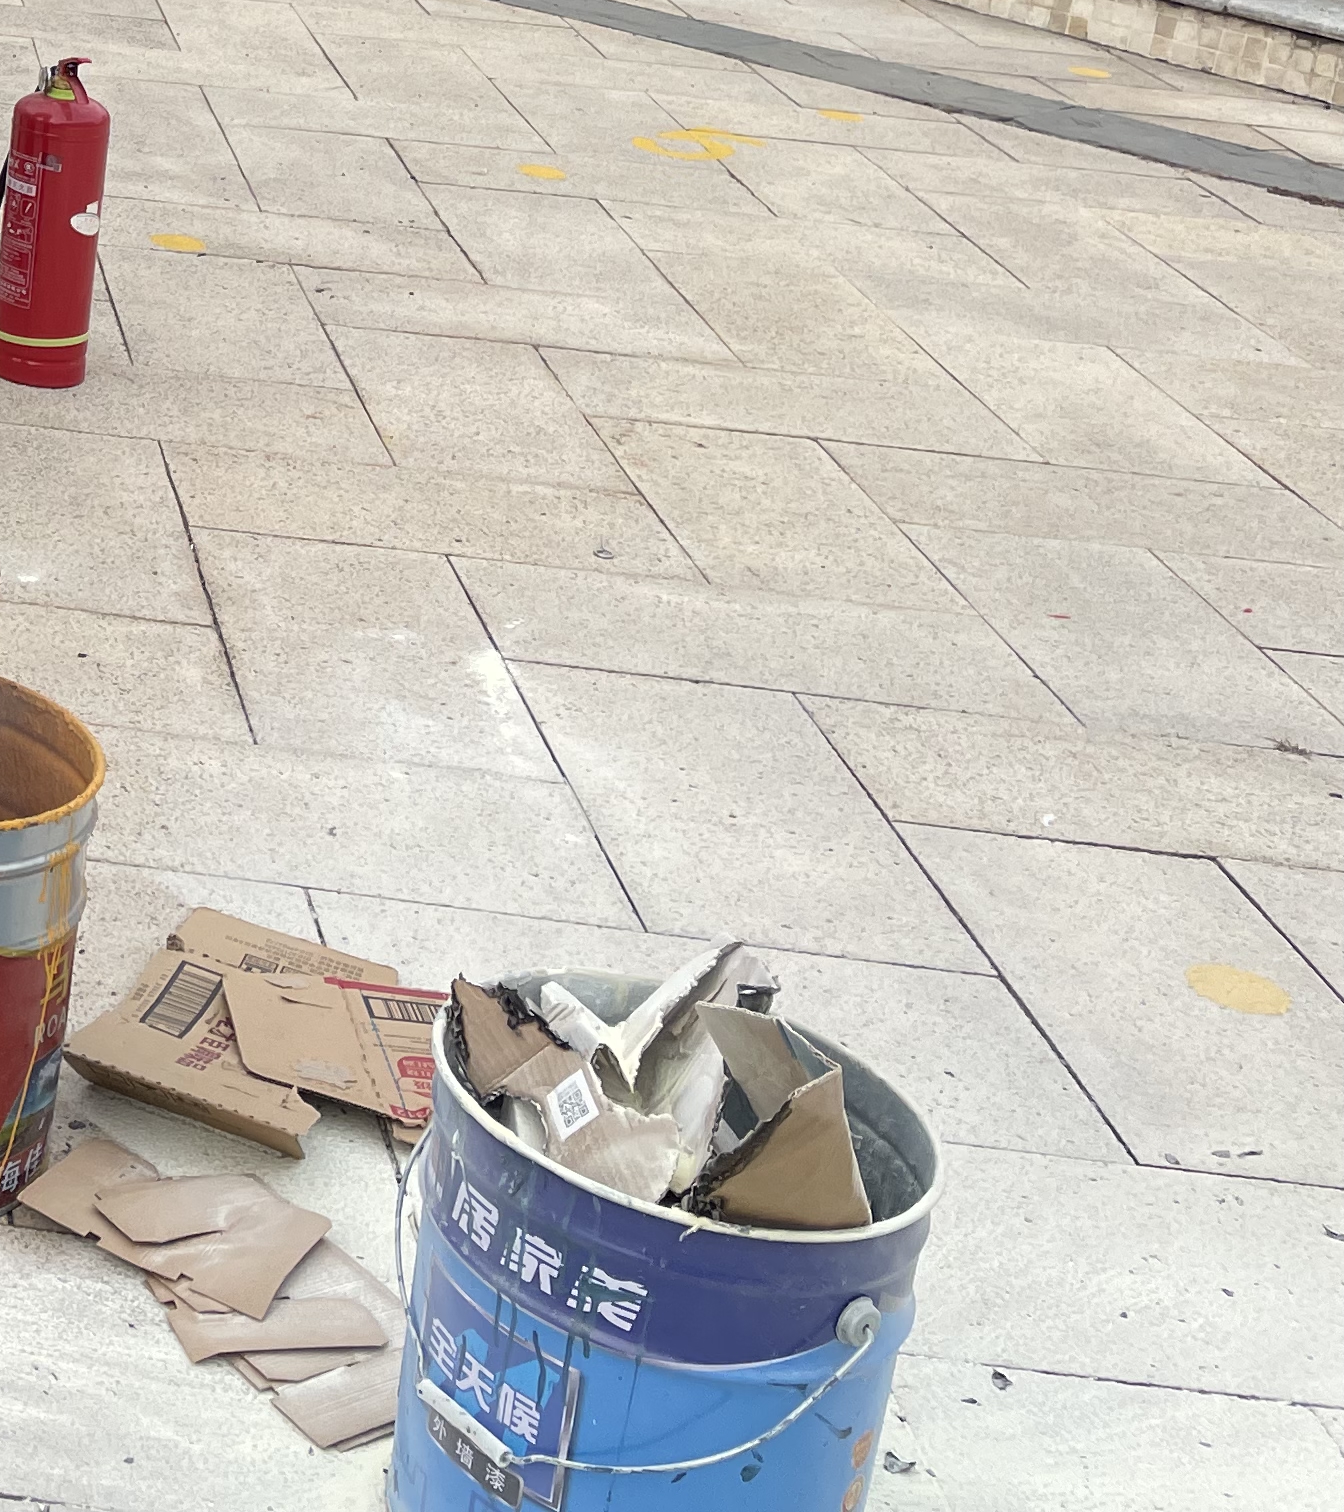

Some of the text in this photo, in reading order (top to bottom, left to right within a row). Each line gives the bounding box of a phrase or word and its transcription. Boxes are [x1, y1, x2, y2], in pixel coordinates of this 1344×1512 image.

[426, 1317, 542, 1445] 全天候
[431, 1414, 507, 1494] 外墙漆
